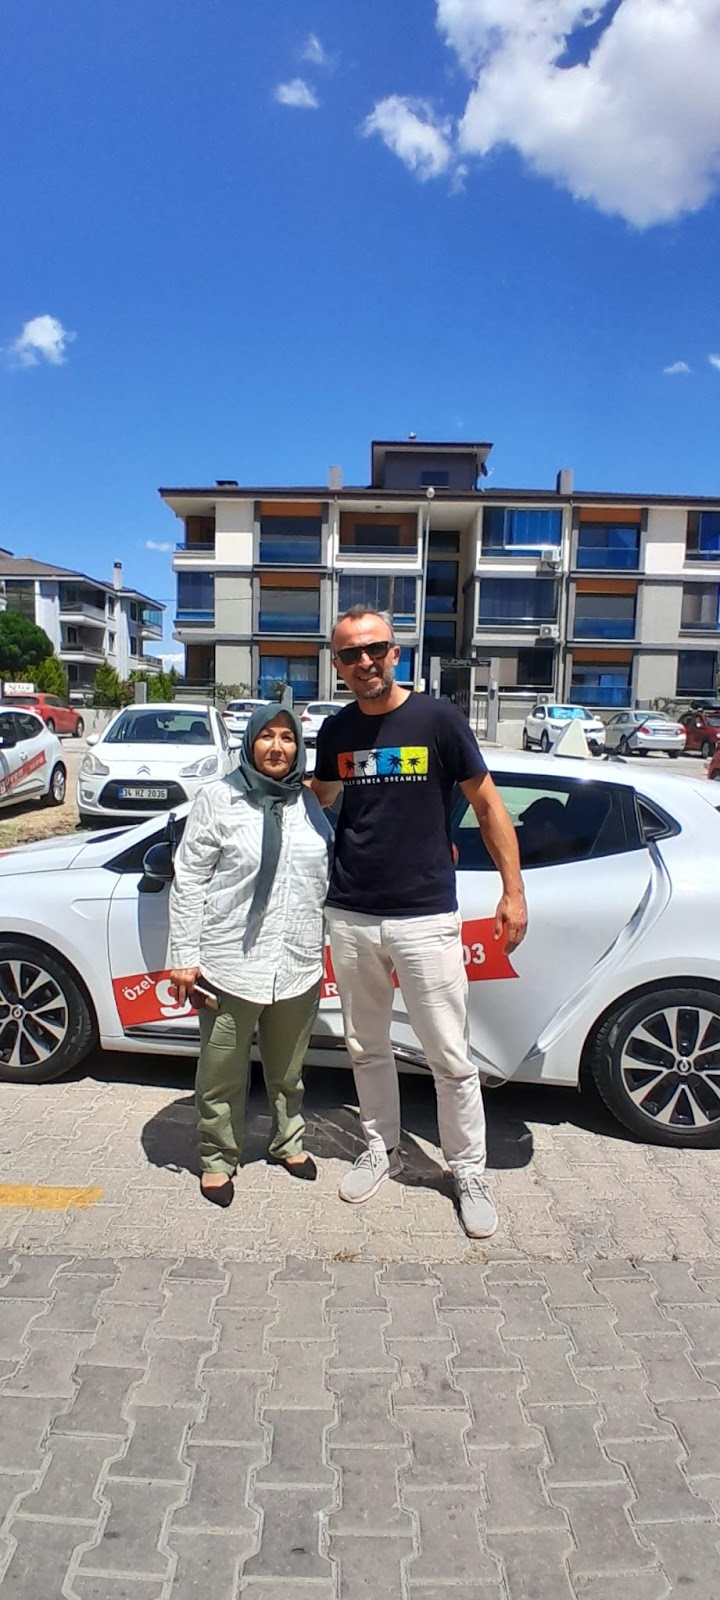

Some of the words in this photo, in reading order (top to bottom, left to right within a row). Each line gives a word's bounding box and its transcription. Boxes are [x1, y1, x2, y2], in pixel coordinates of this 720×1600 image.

[344, 777, 381, 786] ALIFORNIA
[123, 788, 132, 797] 34
[135, 789, 144, 798] HZ
[121, 974, 156, 1001] Özel
